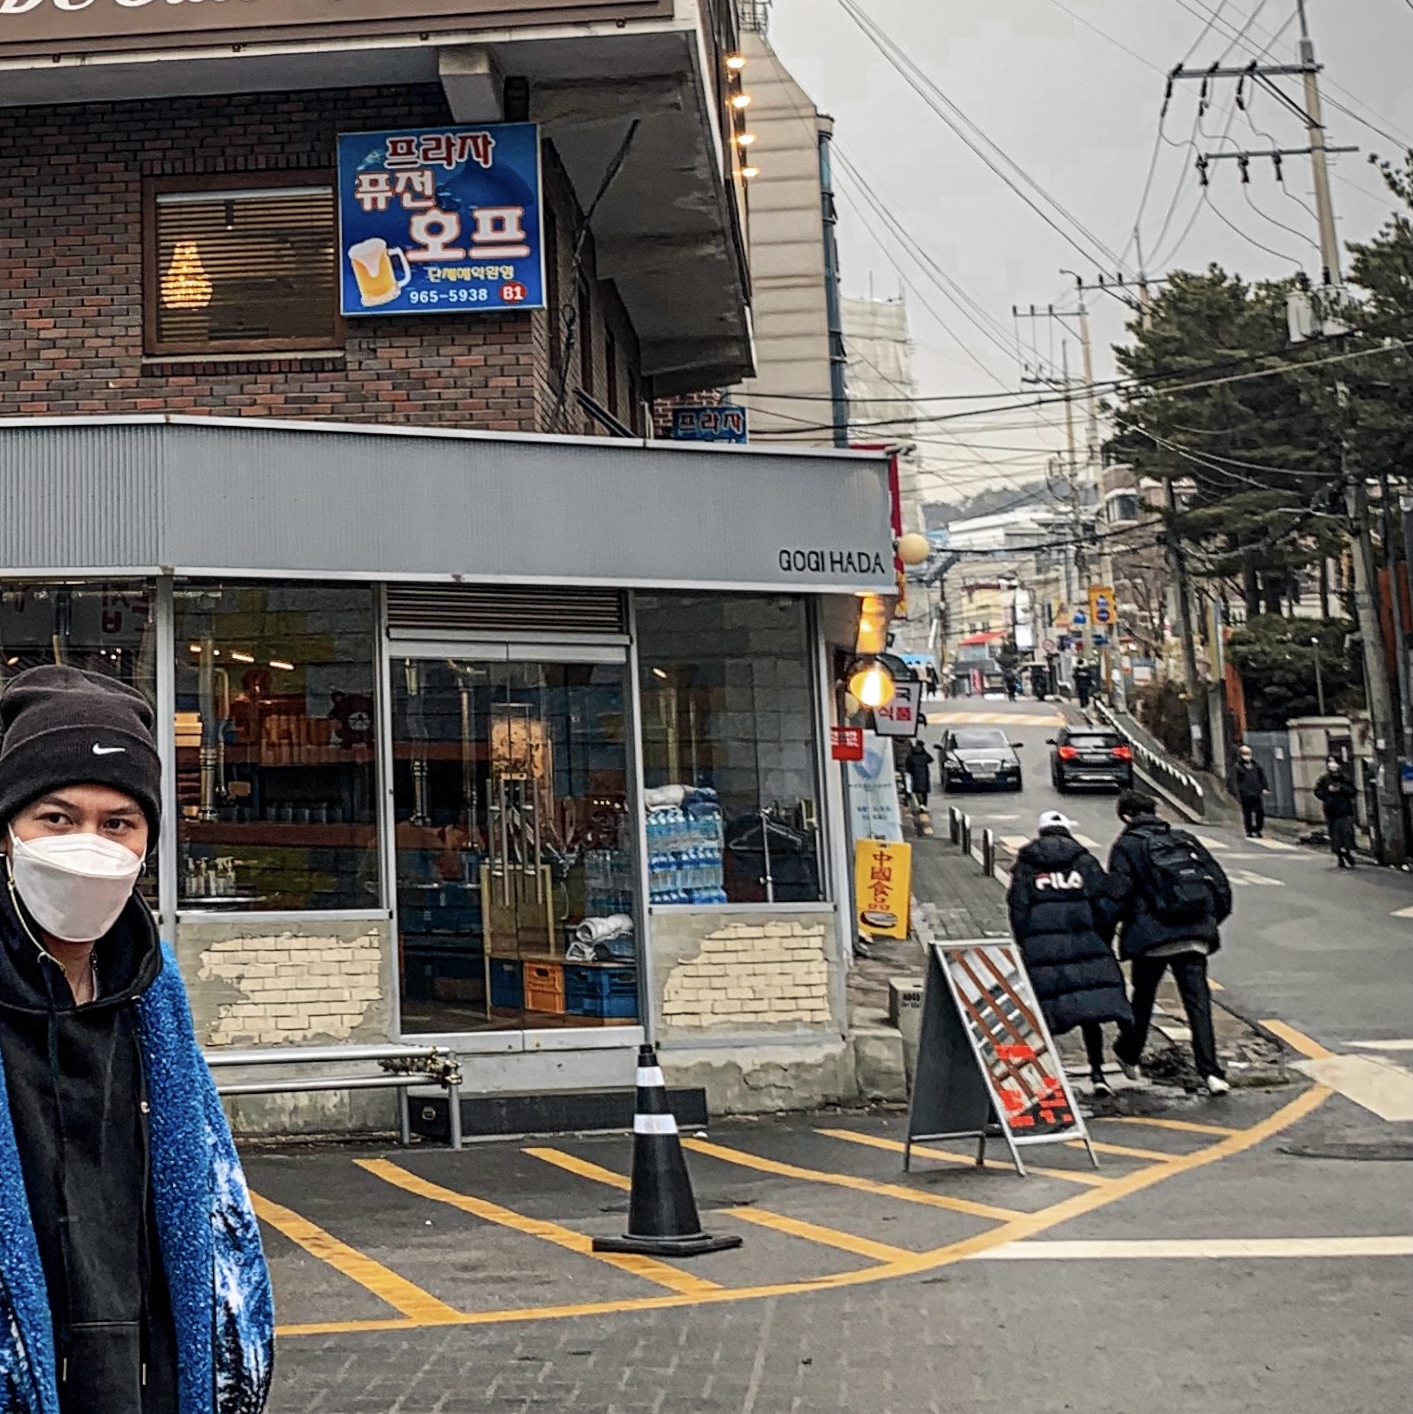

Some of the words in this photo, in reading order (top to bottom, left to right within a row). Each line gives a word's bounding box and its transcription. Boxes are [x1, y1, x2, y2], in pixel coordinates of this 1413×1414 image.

[384, 131, 495, 170] 프라자
[355, 169, 436, 212] 퓨전
[405, 206, 531, 262] 호프
[409, 287, 488, 305] 965-5938
[502, 285, 524, 301] B1
[778, 549, 825, 573] GOGI
[829, 550, 885, 574] HADA
[867, 850, 894, 912] 中國食品
[1035, 870, 1084, 890] FILA
